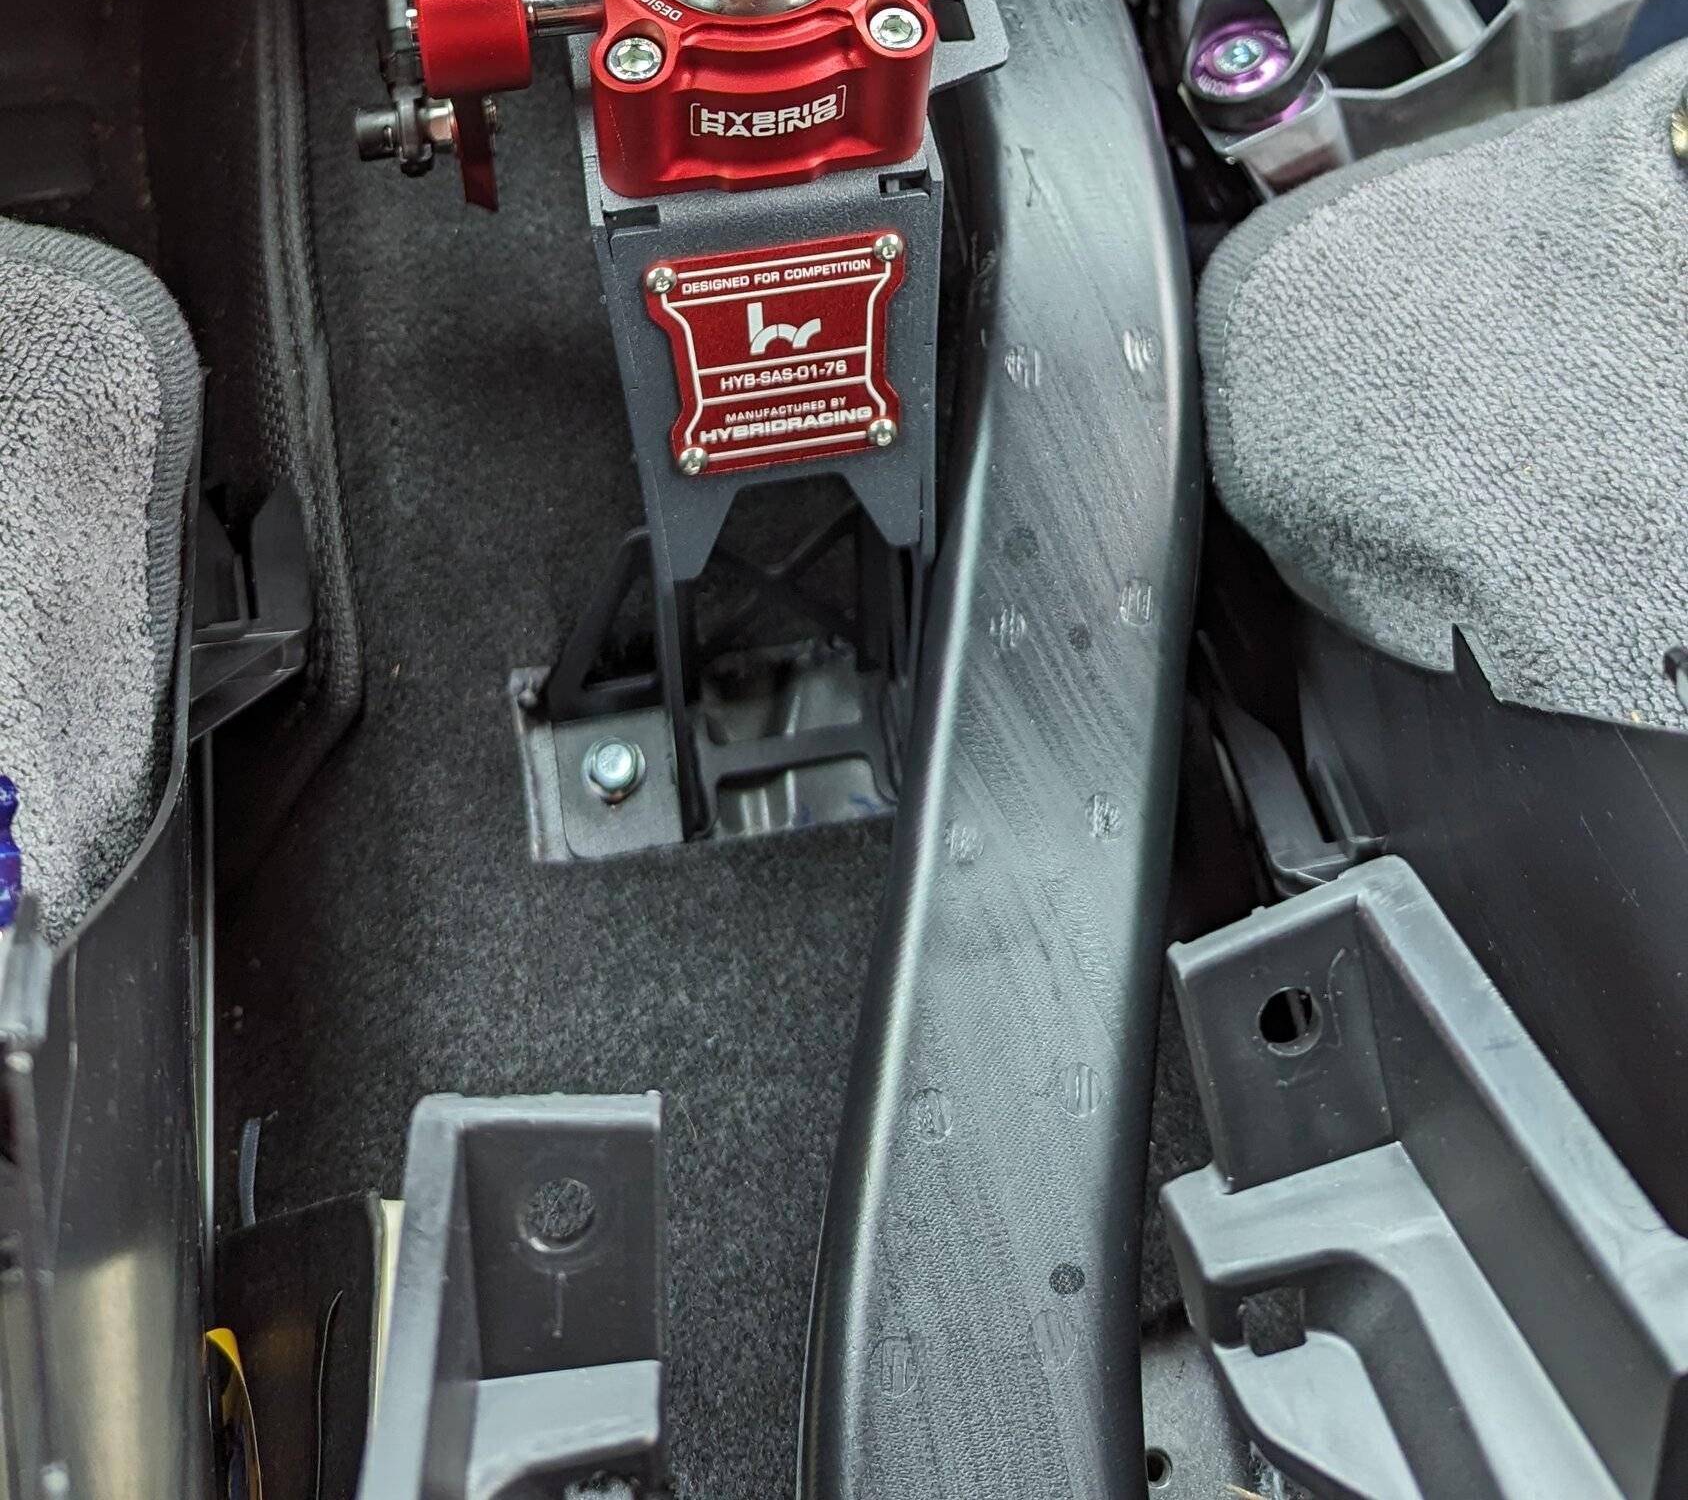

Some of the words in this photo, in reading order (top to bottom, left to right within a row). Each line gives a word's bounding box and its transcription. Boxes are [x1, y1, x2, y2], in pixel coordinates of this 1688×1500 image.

[701, 93, 837, 125] HYBRID
[701, 104, 837, 137] RACING
[682, 275, 750, 295] DESIGNED
[754, 271, 780, 285] FOR
[784, 259, 871, 282] COMPETITION
[720, 360, 848, 391] HYB-SAS-01-76
[700, 406, 873, 445] HYBRIDRACING
[724, 399, 826, 424] MANUFACTURED
[830, 396, 847, 408] BY
